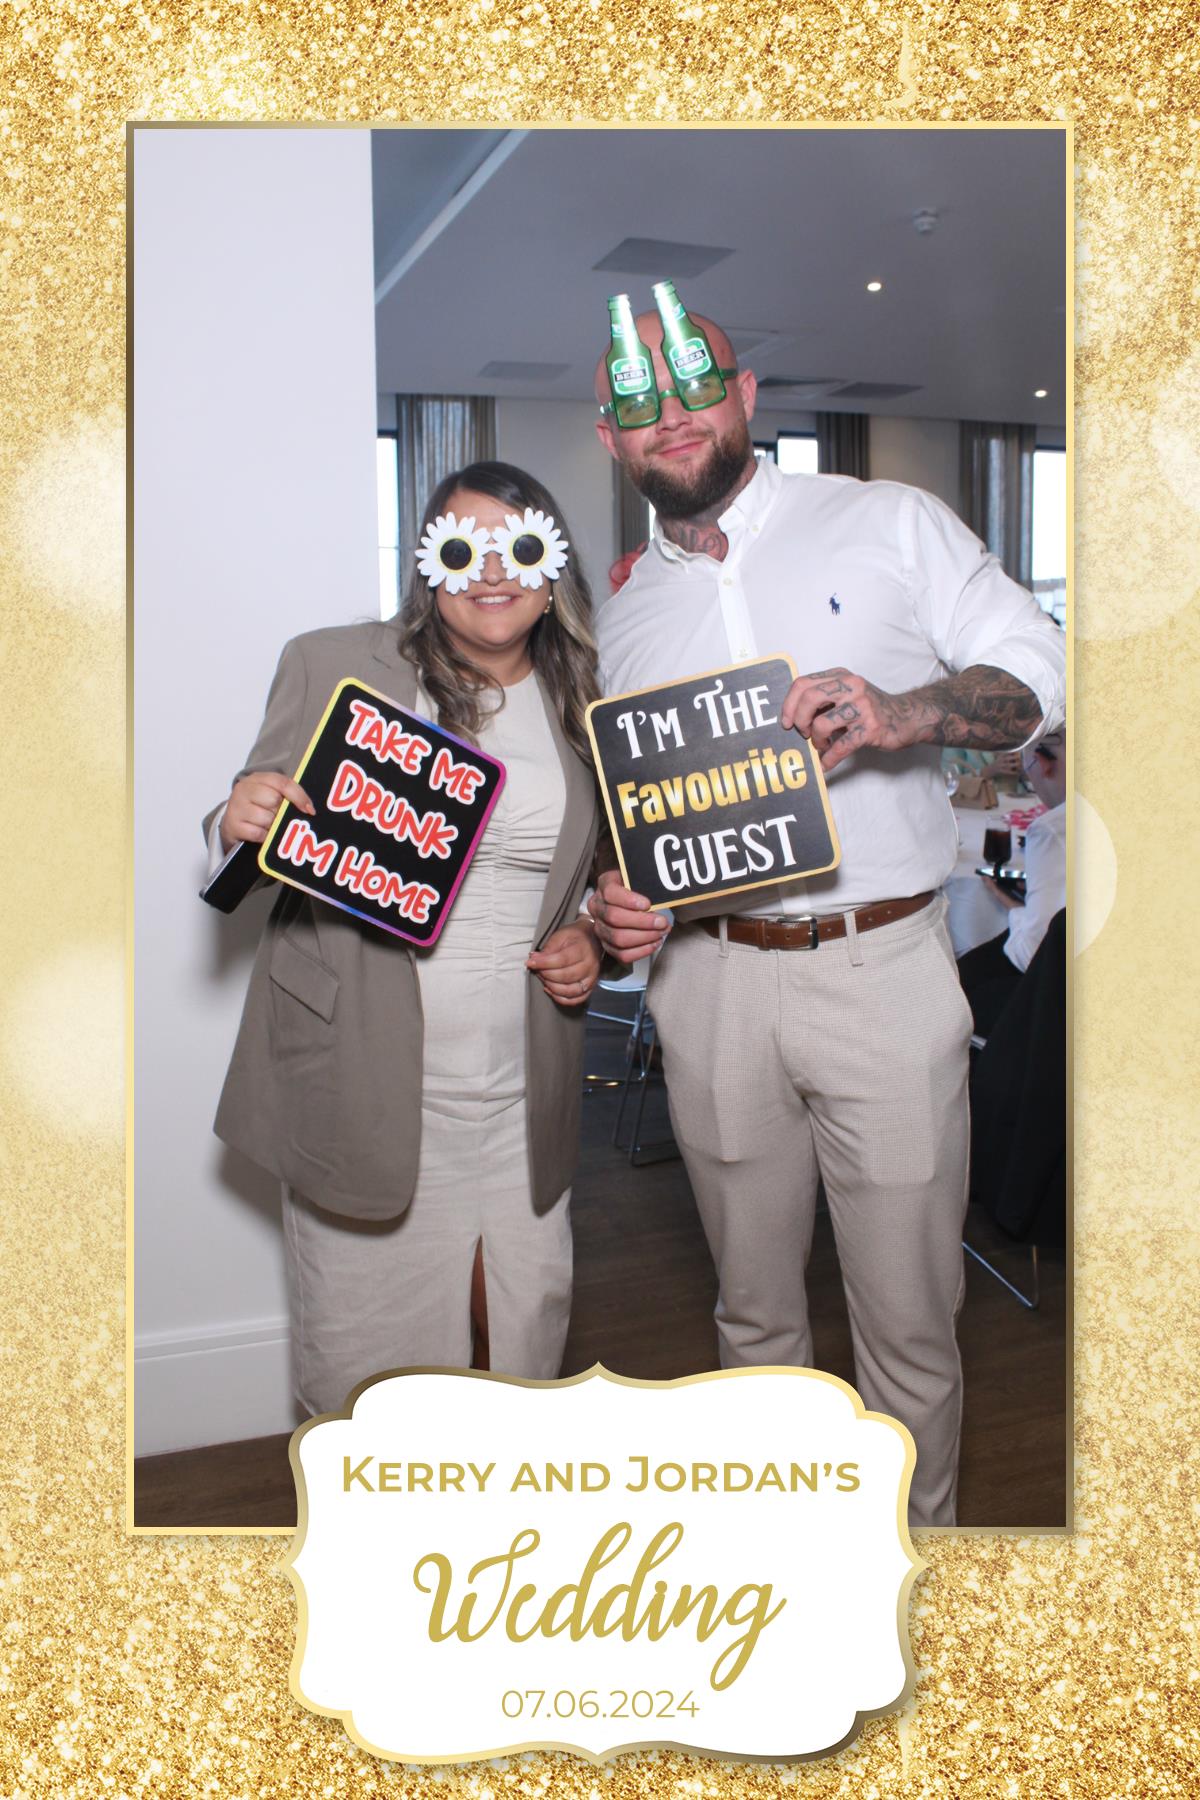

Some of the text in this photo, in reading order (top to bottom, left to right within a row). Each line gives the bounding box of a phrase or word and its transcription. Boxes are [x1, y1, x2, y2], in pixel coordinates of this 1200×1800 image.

[616, 369, 645, 381] BEER
[345, 699, 486, 804] TAKE ME
[616, 679, 777, 759] I'M THE
[327, 760, 458, 859] DRUNK
[617, 746, 807, 829] Favourite
[277, 819, 440, 924] I'M HOME
[653, 814, 797, 892] GUEST
